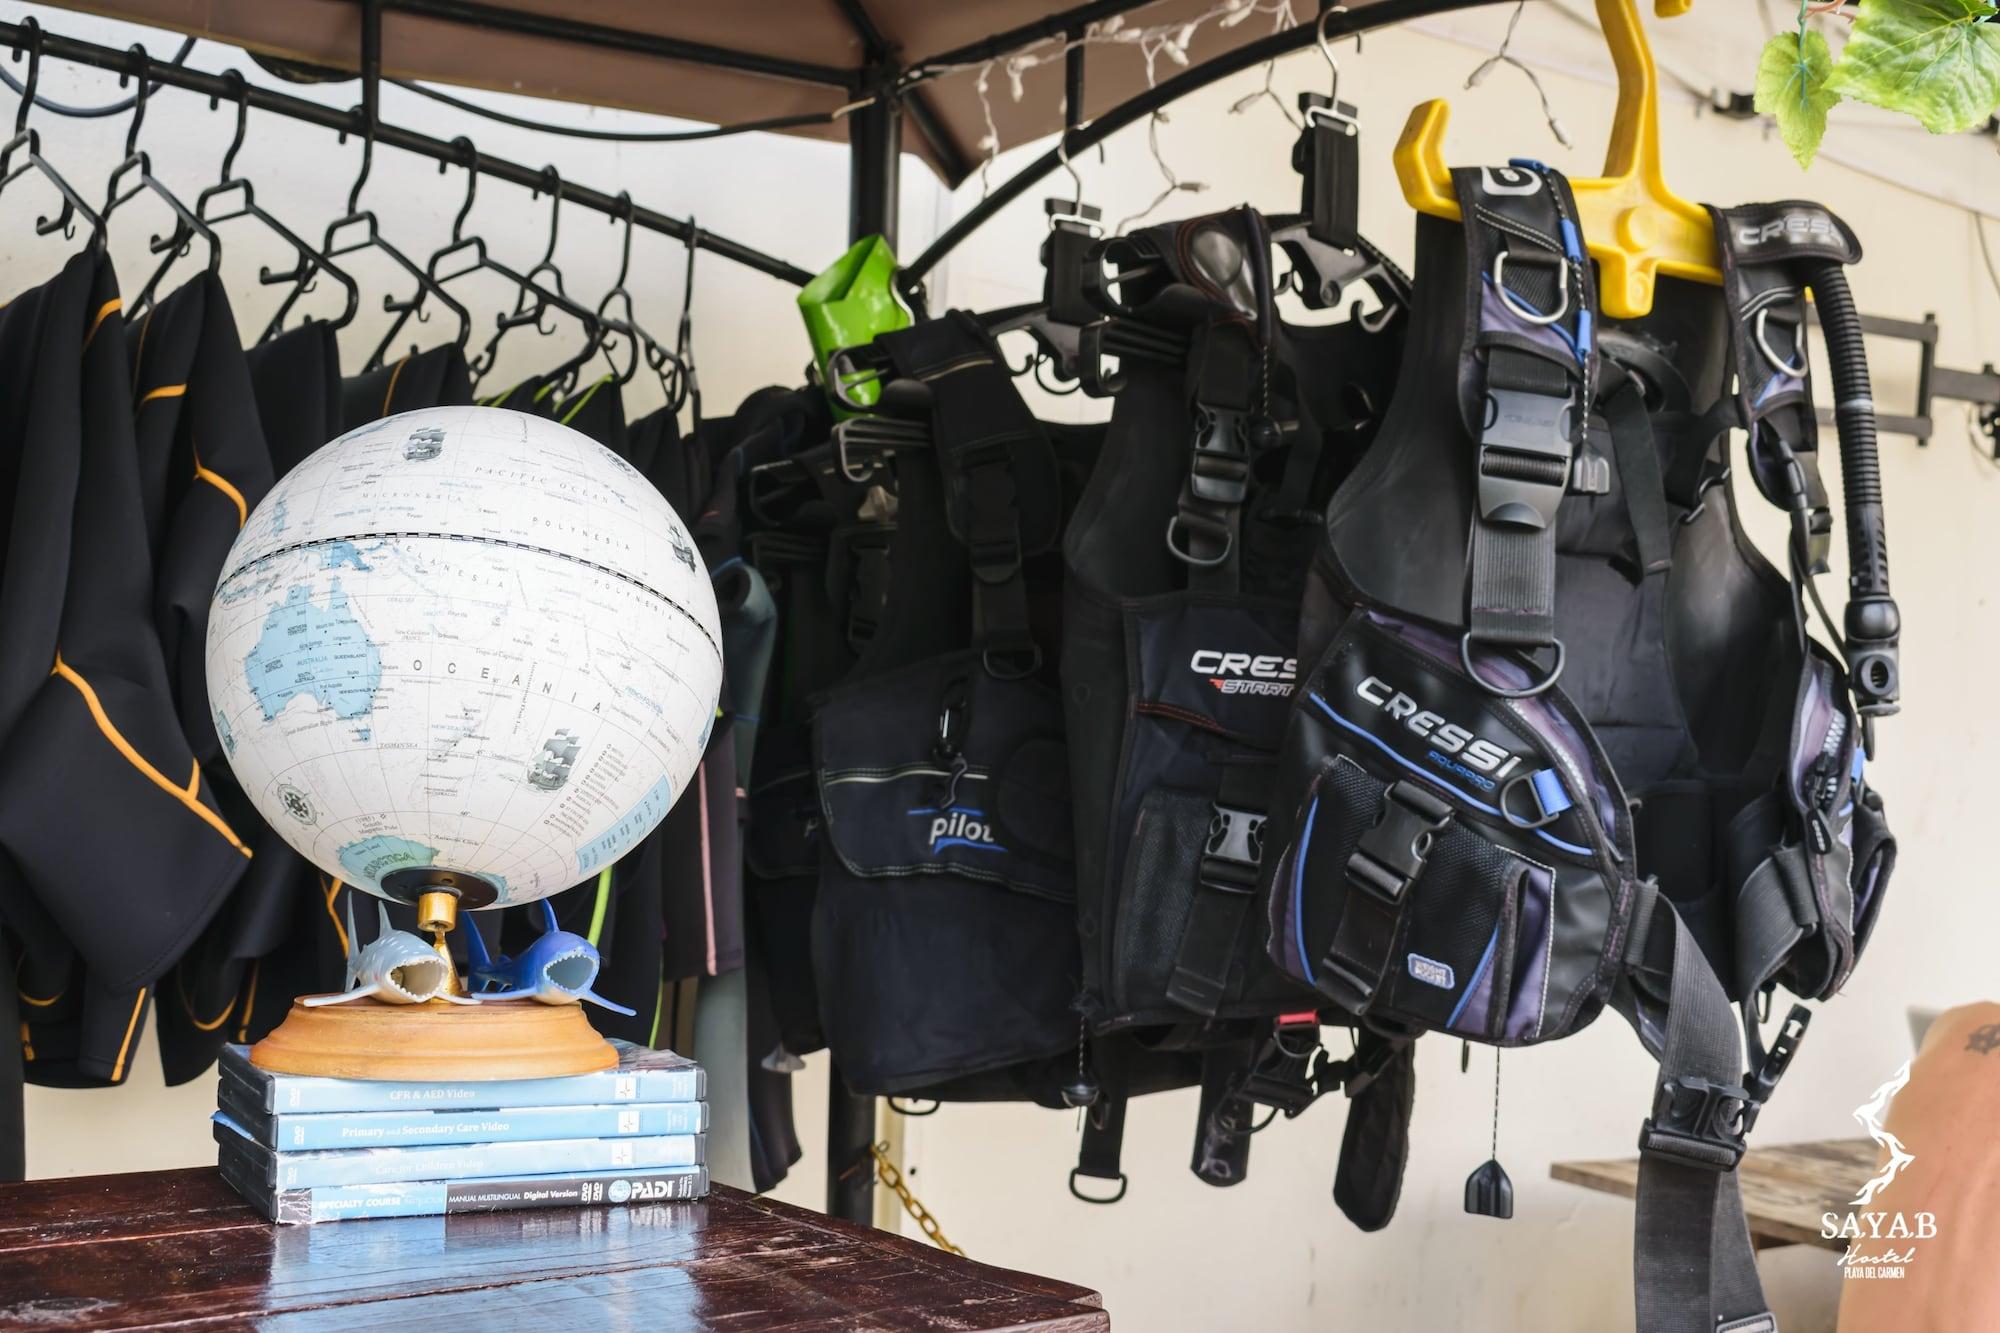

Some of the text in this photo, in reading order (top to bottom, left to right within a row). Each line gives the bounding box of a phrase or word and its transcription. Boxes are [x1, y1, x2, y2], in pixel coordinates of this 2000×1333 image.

[474, 466, 547, 484] PACIFIC
[559, 482, 608, 503] OCEAN
[532, 516, 630, 550] POLYNESIA
[395, 539, 503, 588] MELANESIA
[594, 579, 672, 621] POLYNESIA
[297, 655, 328, 666] AUSTRALIA
[413, 659, 601, 713] OCEANIA
[1354, 674, 1524, 780] CRESSI
[414, 1090, 421, 1099] &
[423, 1090, 445, 1099] AED
[447, 1088, 475, 1099] Video
[342, 1126, 385, 1139] Primary
[402, 1125, 454, 1137] Secondary
[457, 1123, 479, 1132] Care
[481, 1121, 509, 1132] Video
[448, 1195, 476, 1203] MANUAL
[523, 1190, 549, 1201] Digital
[550, 1189, 578, 1198] Version
[631, 1180, 675, 1199] PADI
[318, 1199, 364, 1210] SPECIALTY
[366, 1197, 401, 1207] COURSE
